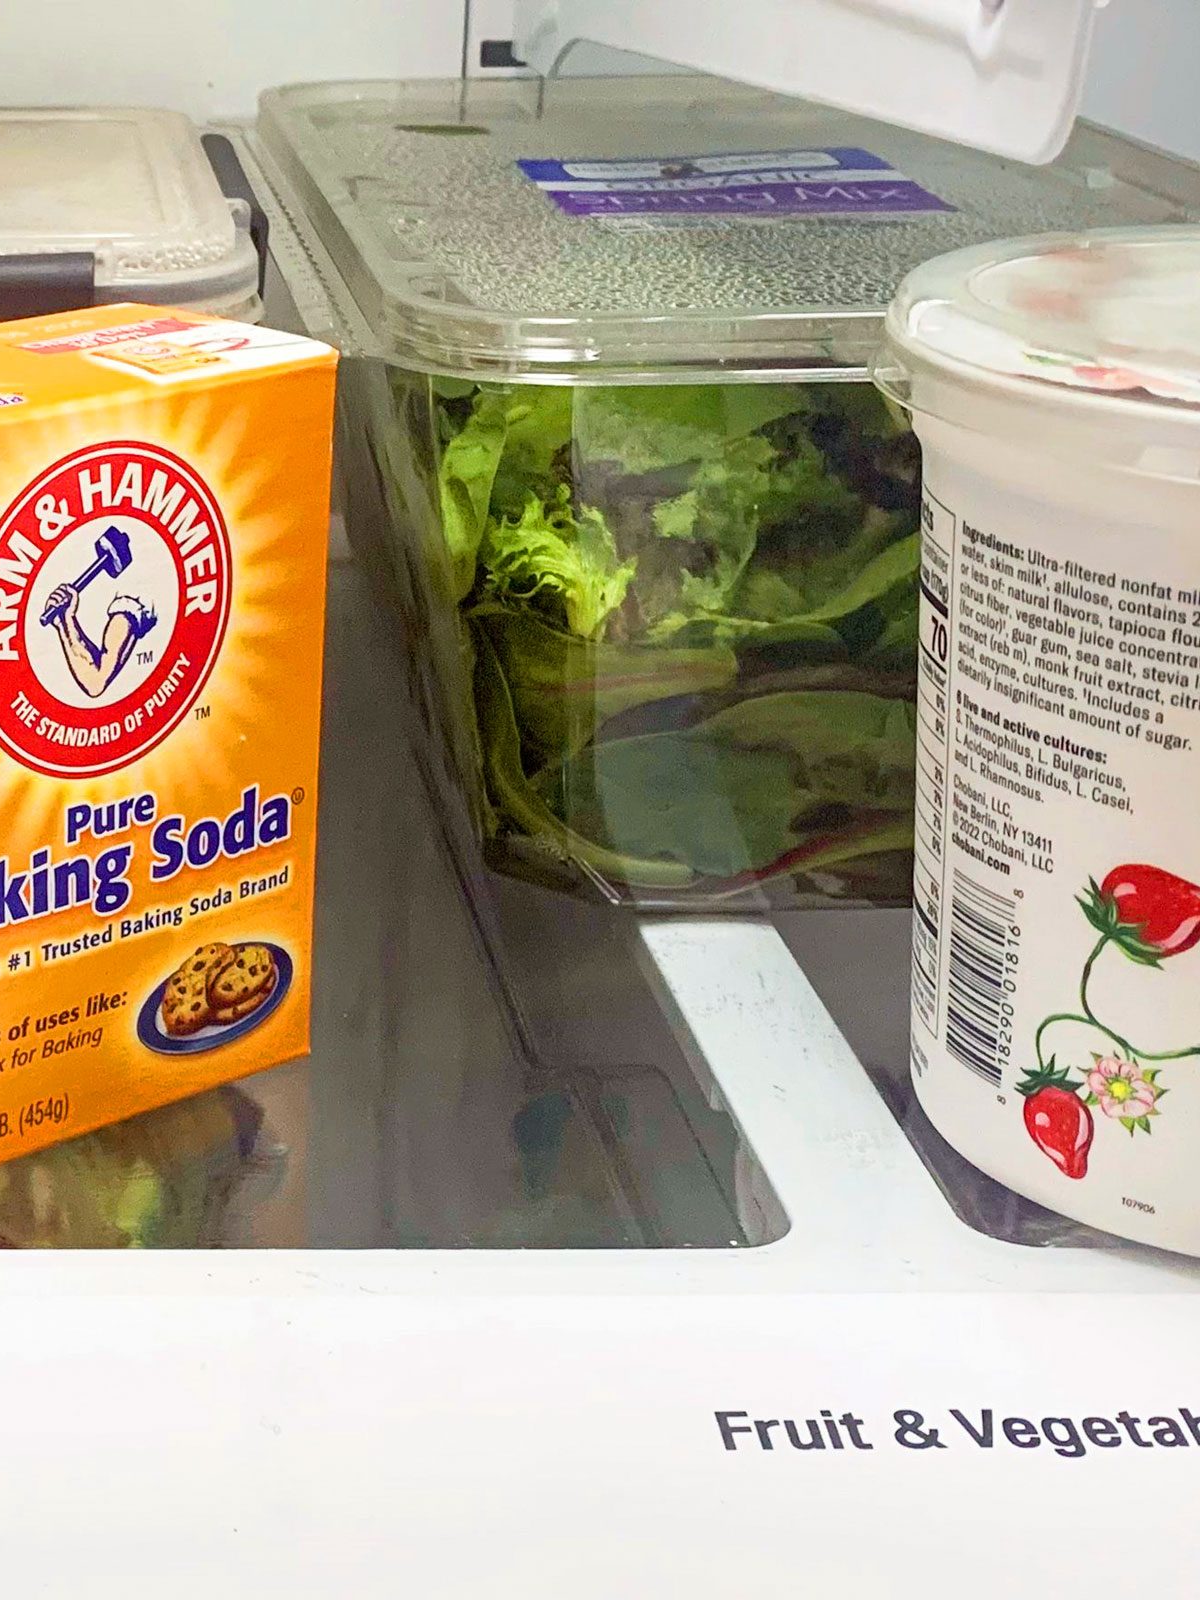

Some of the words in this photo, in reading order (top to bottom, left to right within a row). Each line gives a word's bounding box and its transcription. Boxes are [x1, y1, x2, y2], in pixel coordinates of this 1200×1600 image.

[793, 185, 910, 204] Mix
[35, 494, 77, 541] &
[78, 462, 218, 617] HAMMER
[963, 520, 1024, 560] Ingredients:
[1027, 550, 1115, 588] Ultra-filtered
[1121, 577, 1172, 601] nonfat
[960, 563, 968, 575] or
[971, 567, 989, 588] less
[992, 576, 1004, 592] of:
[1008, 583, 1049, 610] natural
[1054, 598, 1102, 629] flavors,
[1109, 615, 1165, 643] tapioca
[961, 544, 987, 568] water,
[990, 556, 1014, 577] skim
[1054, 581, 1113, 611] allulose,
[1118, 598, 1187, 624] contains
[137, 651, 153, 665] TM
[931, 615, 948, 662] 70
[959, 600, 973, 621] (for
[1012, 628, 1037, 648] guar
[1041, 638, 1071, 660] gum,
[1076, 648, 1099, 666] sea
[1105, 655, 1136, 679] salt,
[1143, 665, 1189, 689] stevia
[960, 582, 984, 605] citrus
[987, 592, 1012, 619] fiber,
[1016, 607, 1075, 639] vegetable
[1079, 627, 1114, 650] juice
[1119, 639, 1200, 669] concentra
[958, 641, 977, 662] acid,
[979, 652, 1019, 682] enzyme,
[1023, 669, 1077, 701] cultures.
[1155, 712, 1164, 724] a
[959, 622, 987, 646] extract
[990, 635, 1010, 657] (reb
[1013, 645, 1030, 667] m),
[1035, 654, 1069, 677] monk
[1074, 665, 1102, 688] fruit
[1107, 678, 1164, 706] extract,
[10, 691, 37, 728] THE
[35, 719, 121, 748] STANDARD
[124, 714, 144, 733] OF
[145, 653, 191, 718] PURITY
[194, 706, 210, 721] TM
[957, 659, 991, 690] dietarily
[994, 676, 1065, 718] insignificant
[1069, 707, 1120, 735] amount
[1126, 723, 1140, 738] of
[1145, 728, 1192, 751] sugar.
[963, 692, 979, 712] live
[981, 705, 1000, 726] and
[1003, 715, 1040, 742] active
[1044, 733, 1108, 764] cultures:
[954, 749, 968, 768] and
[970, 757, 977, 774] L.
[980, 763, 1044, 803] Rhamnosus.
[963, 730, 1021, 777] Acidophilus,
[1026, 763, 1071, 795] Bifidus,
[1076, 782, 1087, 799] L.
[1092, 786, 1134, 815] Casei,
[964, 711, 1034, 763] Thermophilus,
[1038, 747, 1048, 765] L.
[1053, 757, 1126, 792] Bulgaricus,
[67, 793, 155, 843] Pure
[952, 791, 968, 814] New
[970, 803, 1000, 834] Berlin,
[1003, 821, 1019, 841] NY
[1022, 830, 1053, 854] 13411
[953, 774, 988, 810] Chobani,
[991, 797, 1013, 820] LLC,
[151, 787, 290, 880] Soda
[952, 832, 1010, 875] chobani.com
[960, 815, 980, 841] 2022
[982, 830, 1028, 866] Chobani,
[1032, 856, 1054, 874] LLC
[8, 950, 32, 972] #1
[42, 926, 113, 963] Trusted
[120, 904, 183, 939] Baking
[189, 890, 232, 916] Soda
[240, 865, 289, 899] Brand
[1001, 925, 1022, 993] 01816
[8, 1013, 29, 1042] of
[35, 1006, 79, 1032] uses
[86, 990, 128, 1017] like:
[11, 1046, 33, 1070] for
[41, 1025, 104, 1060] Baking
[998, 1003, 1015, 1066] 18290
[18, 1093, 69, 1138] (454g)
[1121, 1197, 1155, 1215] 107906
[715, 1410, 873, 1450] Fruit
[893, 1409, 948, 1449] &
